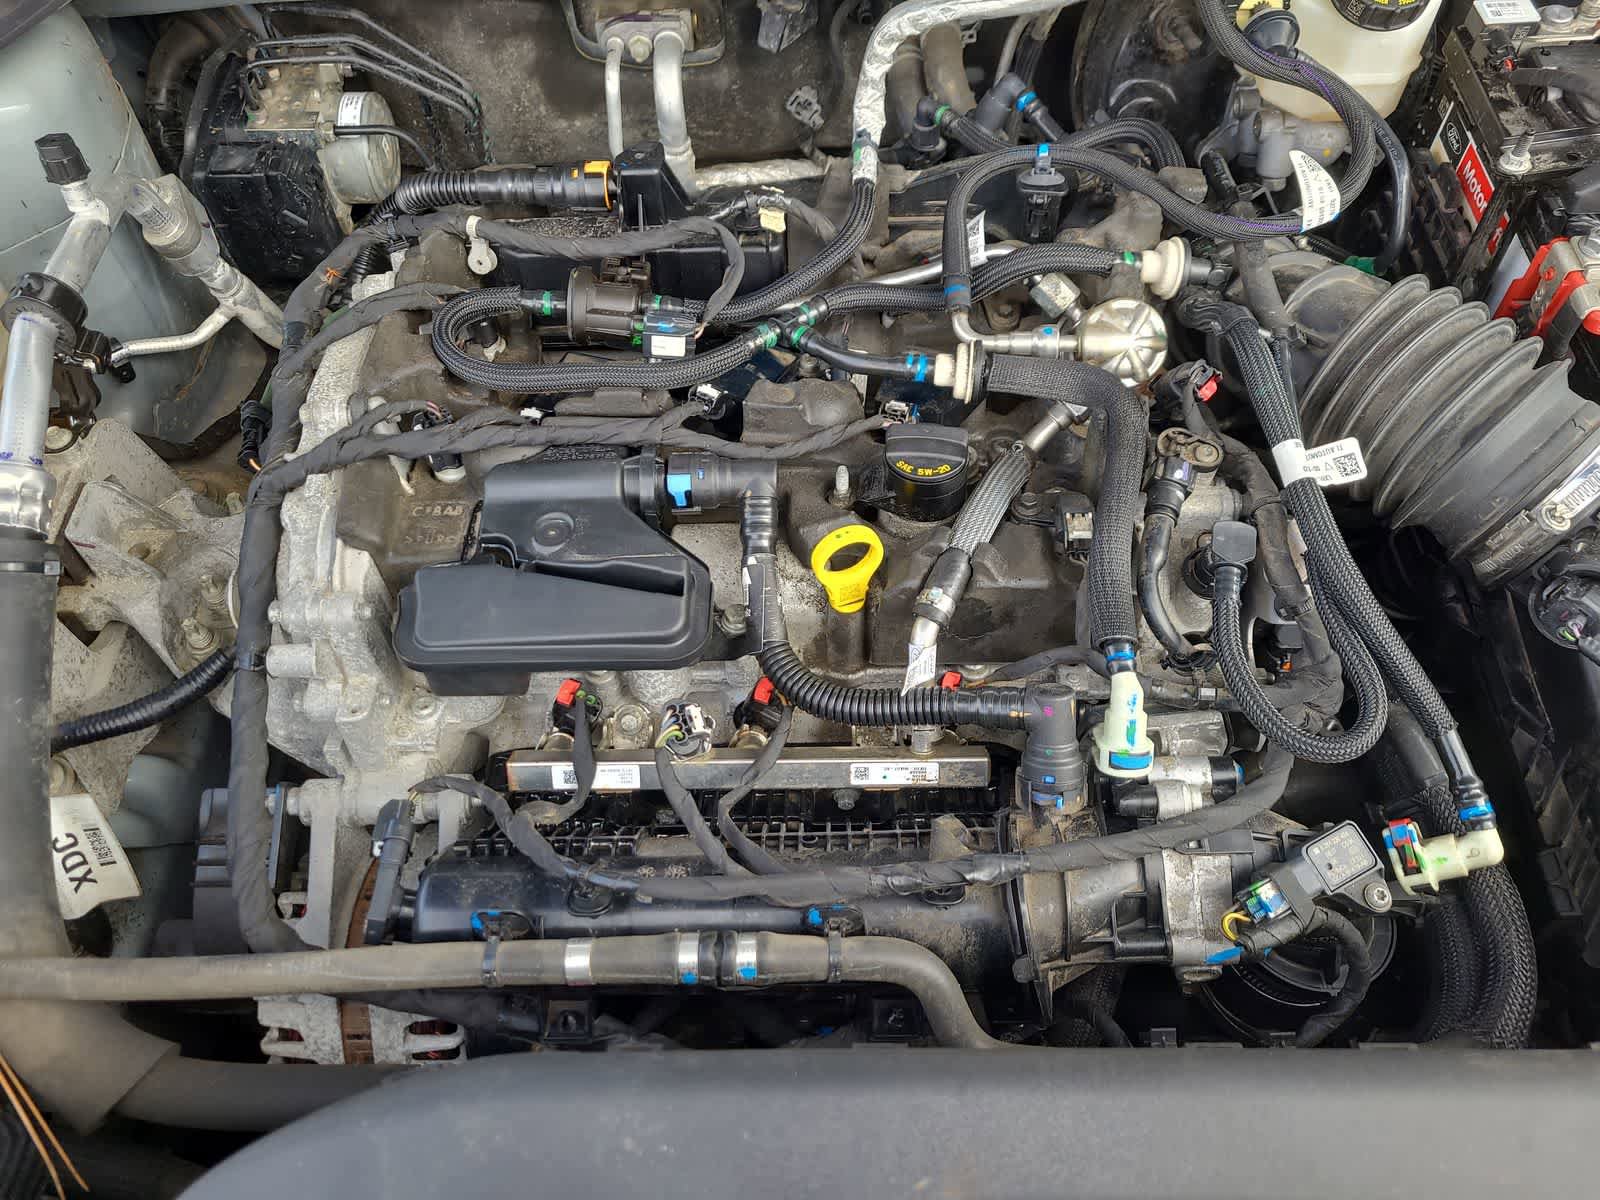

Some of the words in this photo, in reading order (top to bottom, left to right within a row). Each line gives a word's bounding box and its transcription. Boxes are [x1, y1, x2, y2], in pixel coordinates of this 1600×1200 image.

[896, 459, 914, 473] SAE
[917, 464, 951, 476] 5W-20
[52, 832, 98, 894] XDC
